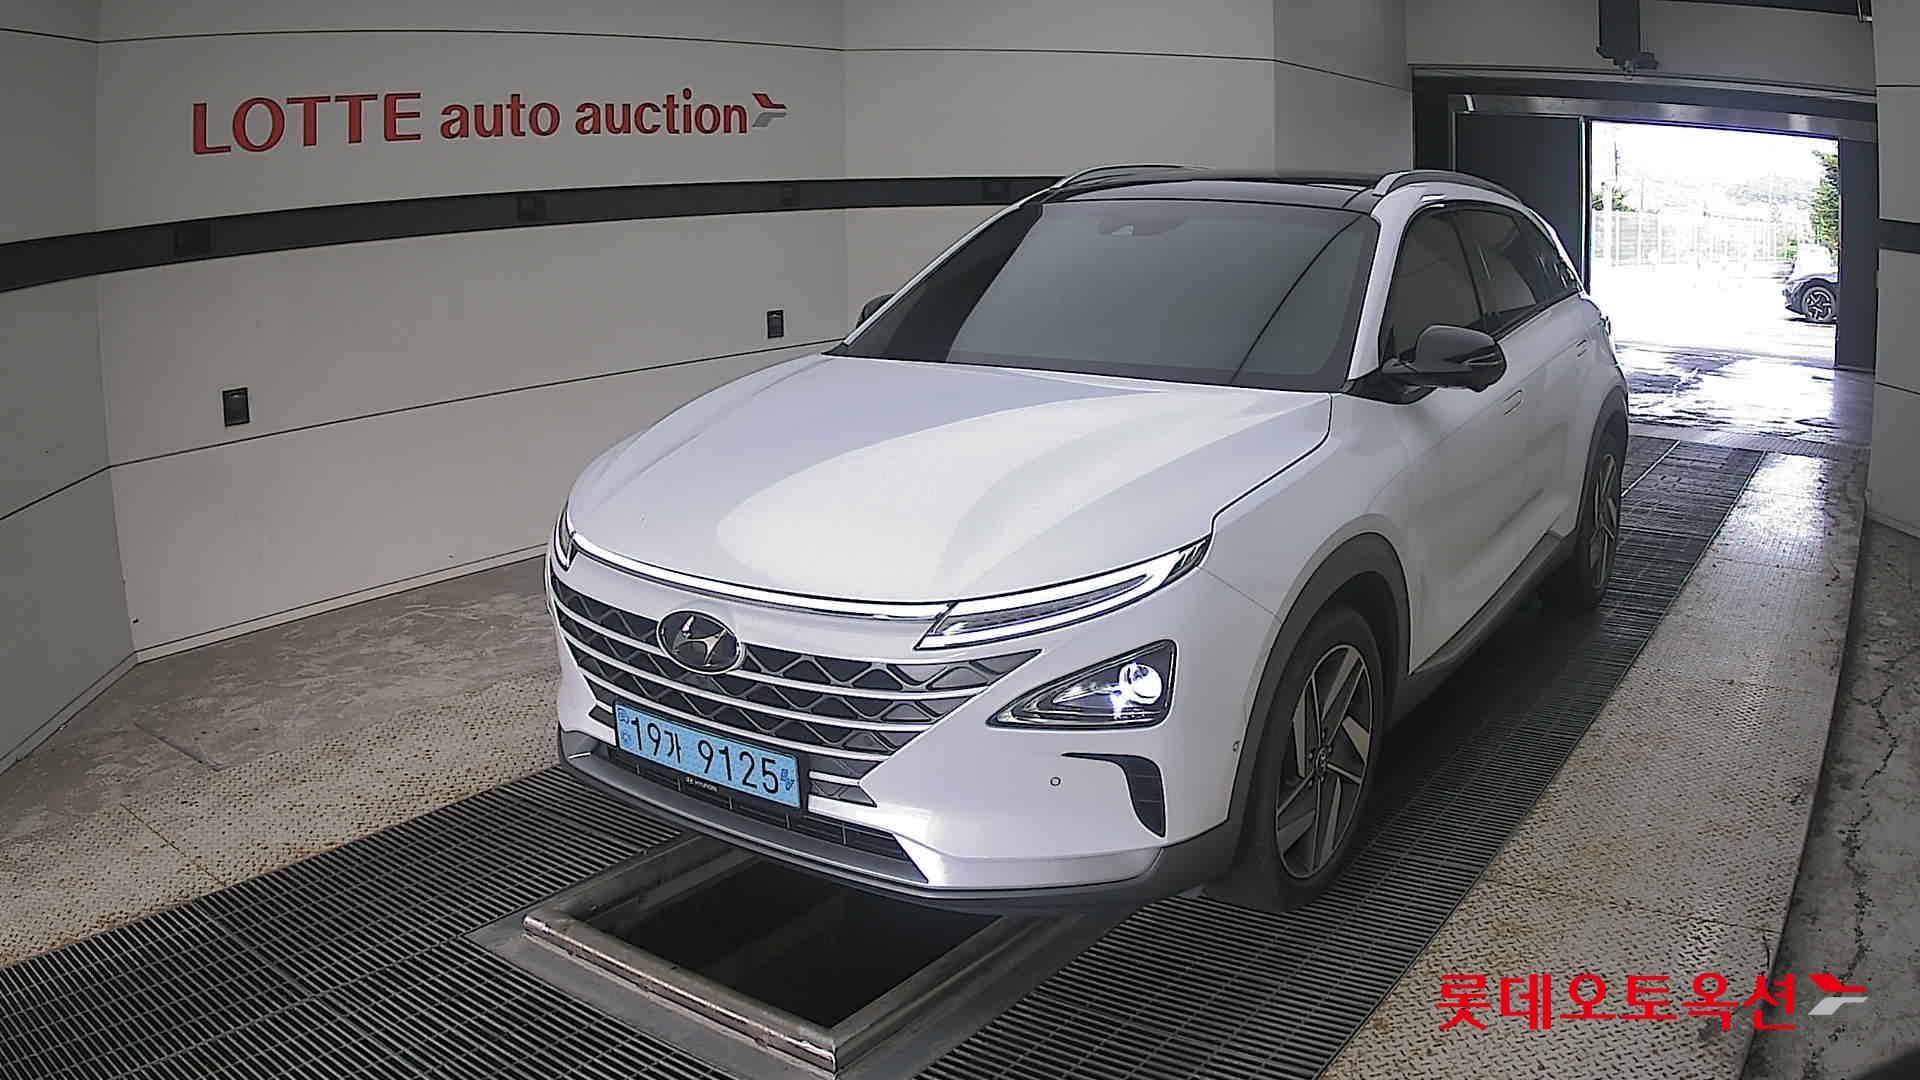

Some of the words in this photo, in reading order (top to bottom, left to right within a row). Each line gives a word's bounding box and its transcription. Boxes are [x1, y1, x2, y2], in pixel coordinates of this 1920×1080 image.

[192, 92, 422, 154] LOTTE
[440, 94, 560, 139] auto
[575, 88, 749, 136] auction
[630, 716, 682, 764] 19가
[698, 740, 779, 794] 9125
